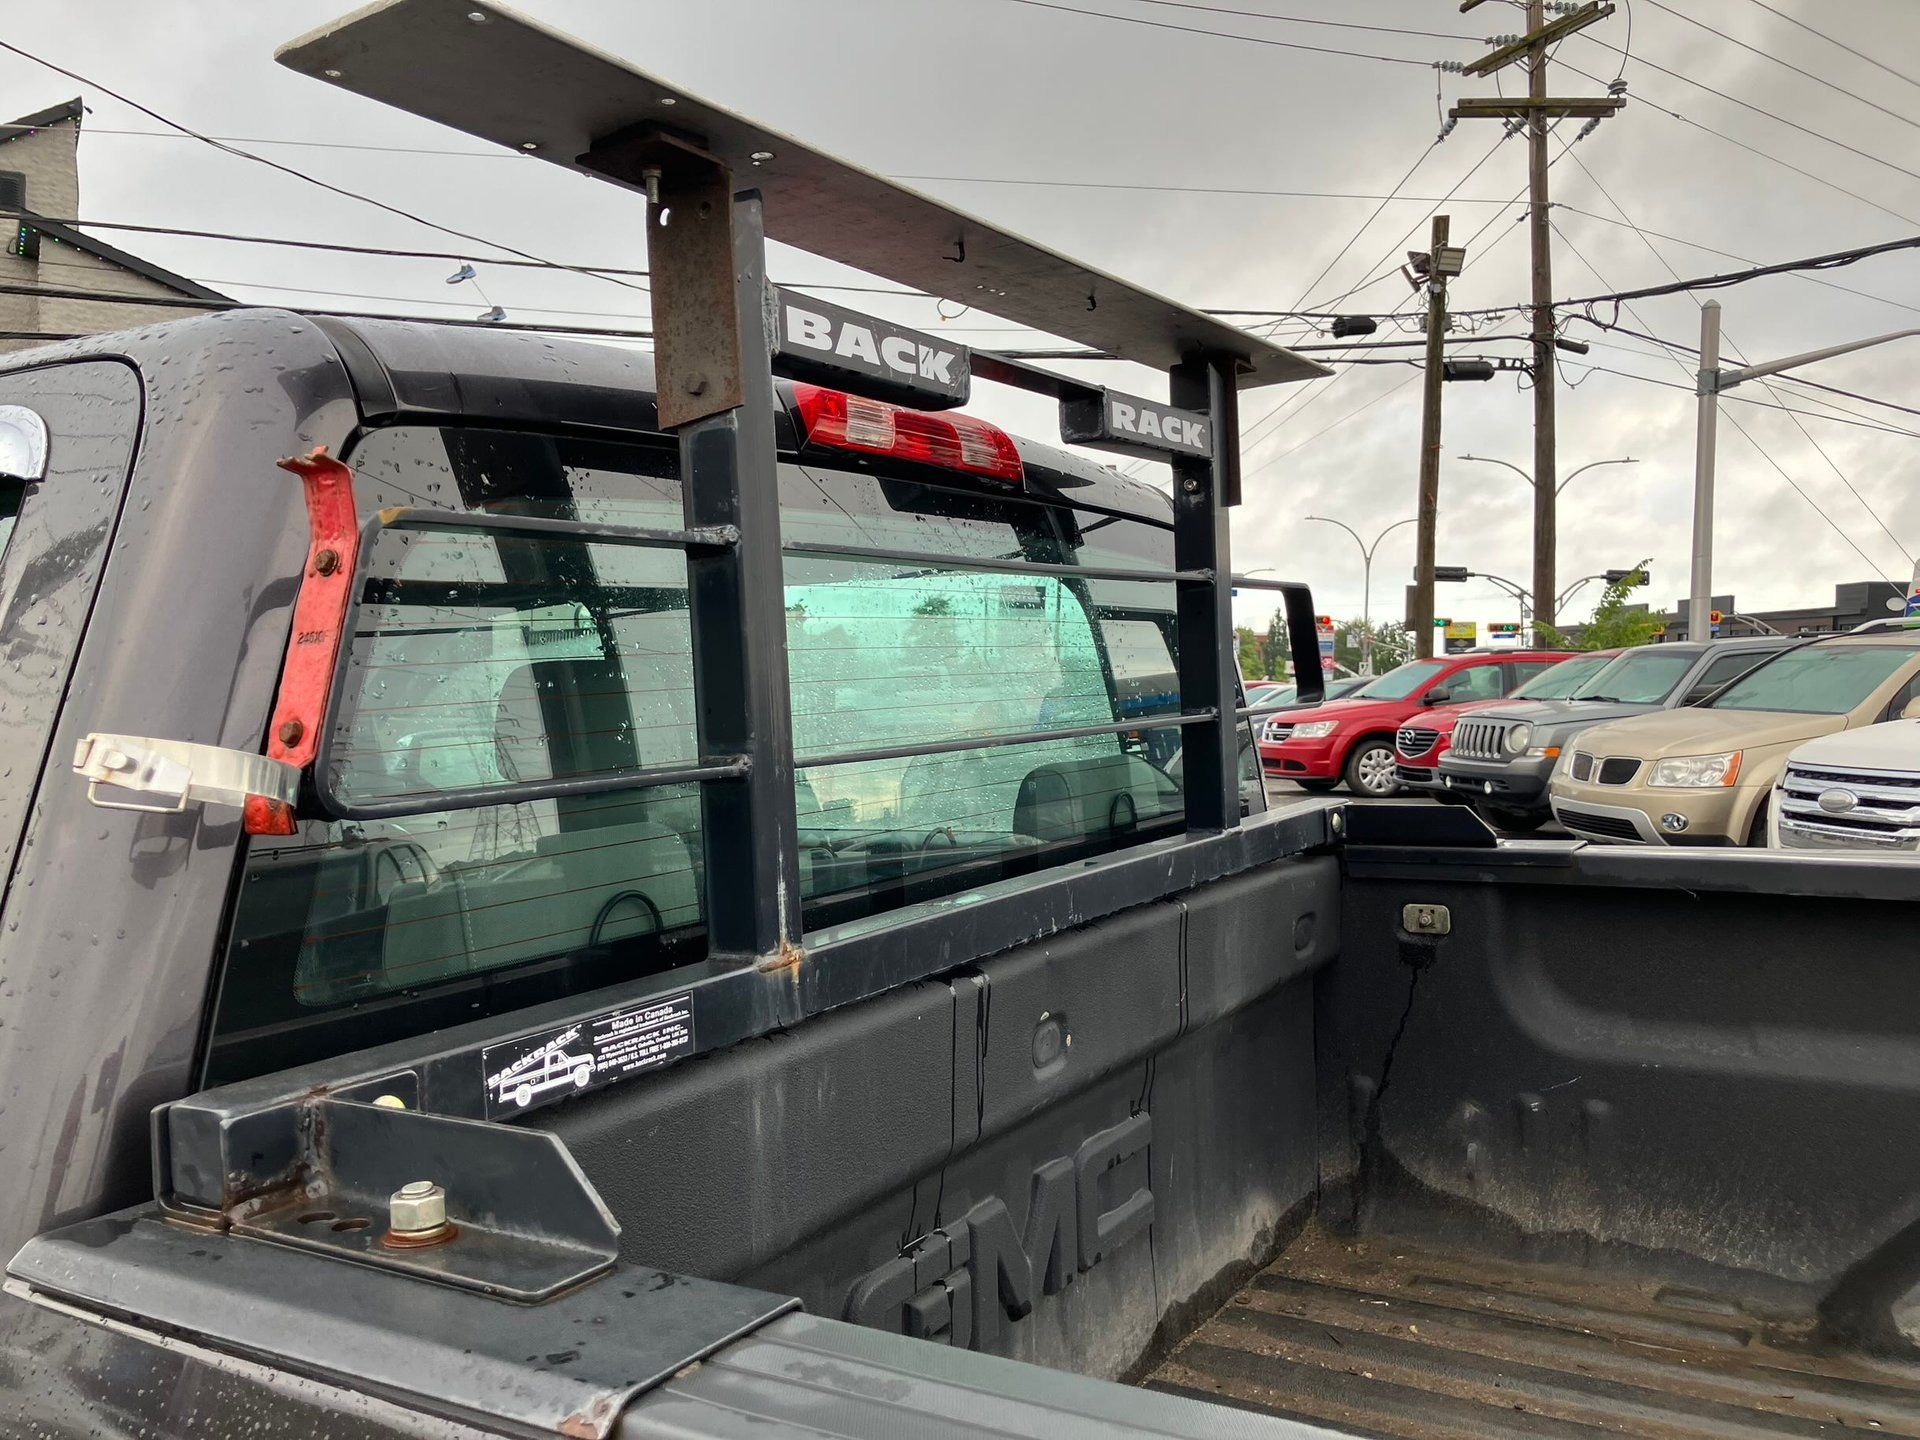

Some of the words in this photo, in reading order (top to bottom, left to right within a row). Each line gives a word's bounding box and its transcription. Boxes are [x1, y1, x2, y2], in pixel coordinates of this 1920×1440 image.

[786, 305, 955, 384] BACK
[1112, 401, 1203, 448] RACK
[601, 1030, 660, 1054] BACKRACK
[662, 1024, 684, 1035] INC.
[611, 1018, 634, 1030] Made
[635, 1015, 643, 1023] in
[644, 1006, 673, 1020] Canada
[488, 1026, 578, 1087] BACKRACK
[841, 1110, 1154, 1348] GMC
